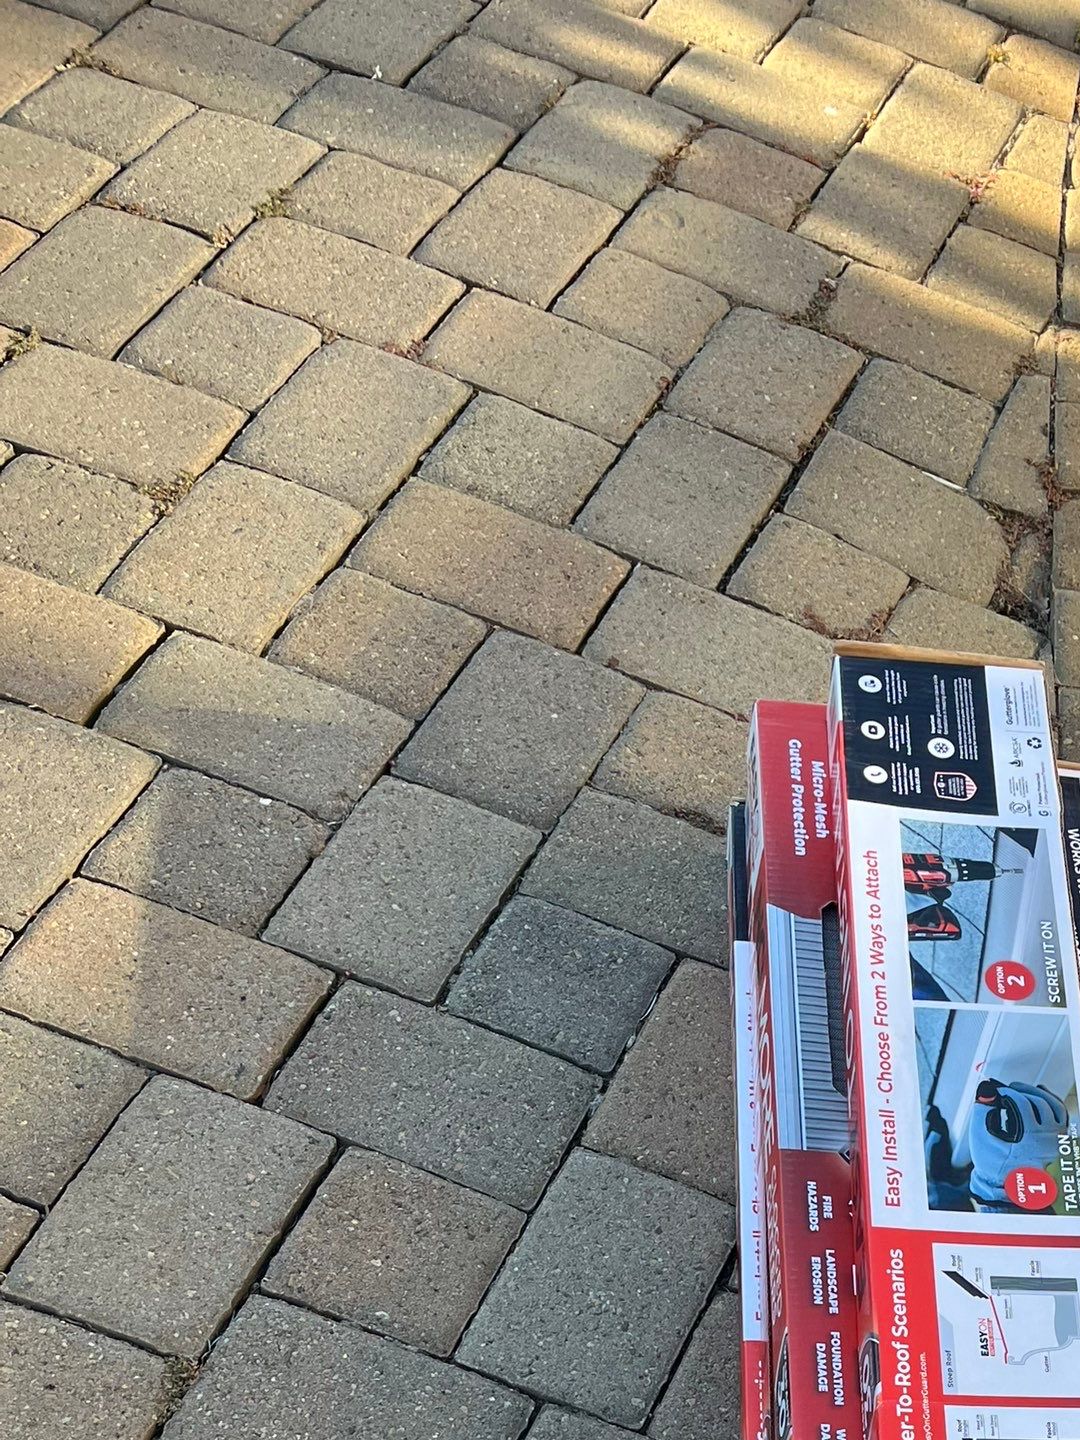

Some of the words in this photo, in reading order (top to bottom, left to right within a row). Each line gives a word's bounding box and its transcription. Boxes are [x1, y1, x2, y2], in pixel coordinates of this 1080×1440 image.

[788, 739, 802, 781] Gutter
[790, 784, 808, 857] Protection
[810, 761, 827, 841] Micro-Mesh
[862, 850, 880, 899] Attach
[868, 903, 881, 919] to
[1040, 921, 1053, 939] ON
[868, 923, 888, 965] Ways
[1042, 941, 1054, 952] IT
[870, 970, 885, 979] 2
[994, 964, 1007, 995] OPTION
[1006, 975, 1024, 986] 2
[1043, 956, 1062, 1004] SCREW
[872, 984, 888, 1026] From
[758, 977, 774, 1171] MORE
[874, 1031, 892, 1092] Choose
[878, 1109, 897, 1160] Install
[1057, 1132, 1073, 1154] ON
[1070, 1122, 1078, 1138] TAPE
[1060, 1158, 1074, 1170] IT
[805, 1178, 820, 1232] HAZARDS
[820, 1193, 833, 1220] FIRE
[883, 1166, 902, 1206] Easy
[1014, 1171, 1028, 1203] OPTION
[1027, 1182, 1046, 1193] 1
[1062, 1174, 1079, 1211] TAPE
[809, 1254, 824, 1306] EROSION
[824, 1247, 839, 1315] LANDSCAPE
[885, 1248, 908, 1336] Scenarios
[814, 1341, 829, 1393] DAMAGE
[828, 1331, 845, 1406] FOUNDATION
[944, 1349, 952, 1365] Roof
[946, 1367, 954, 1387] Steep
